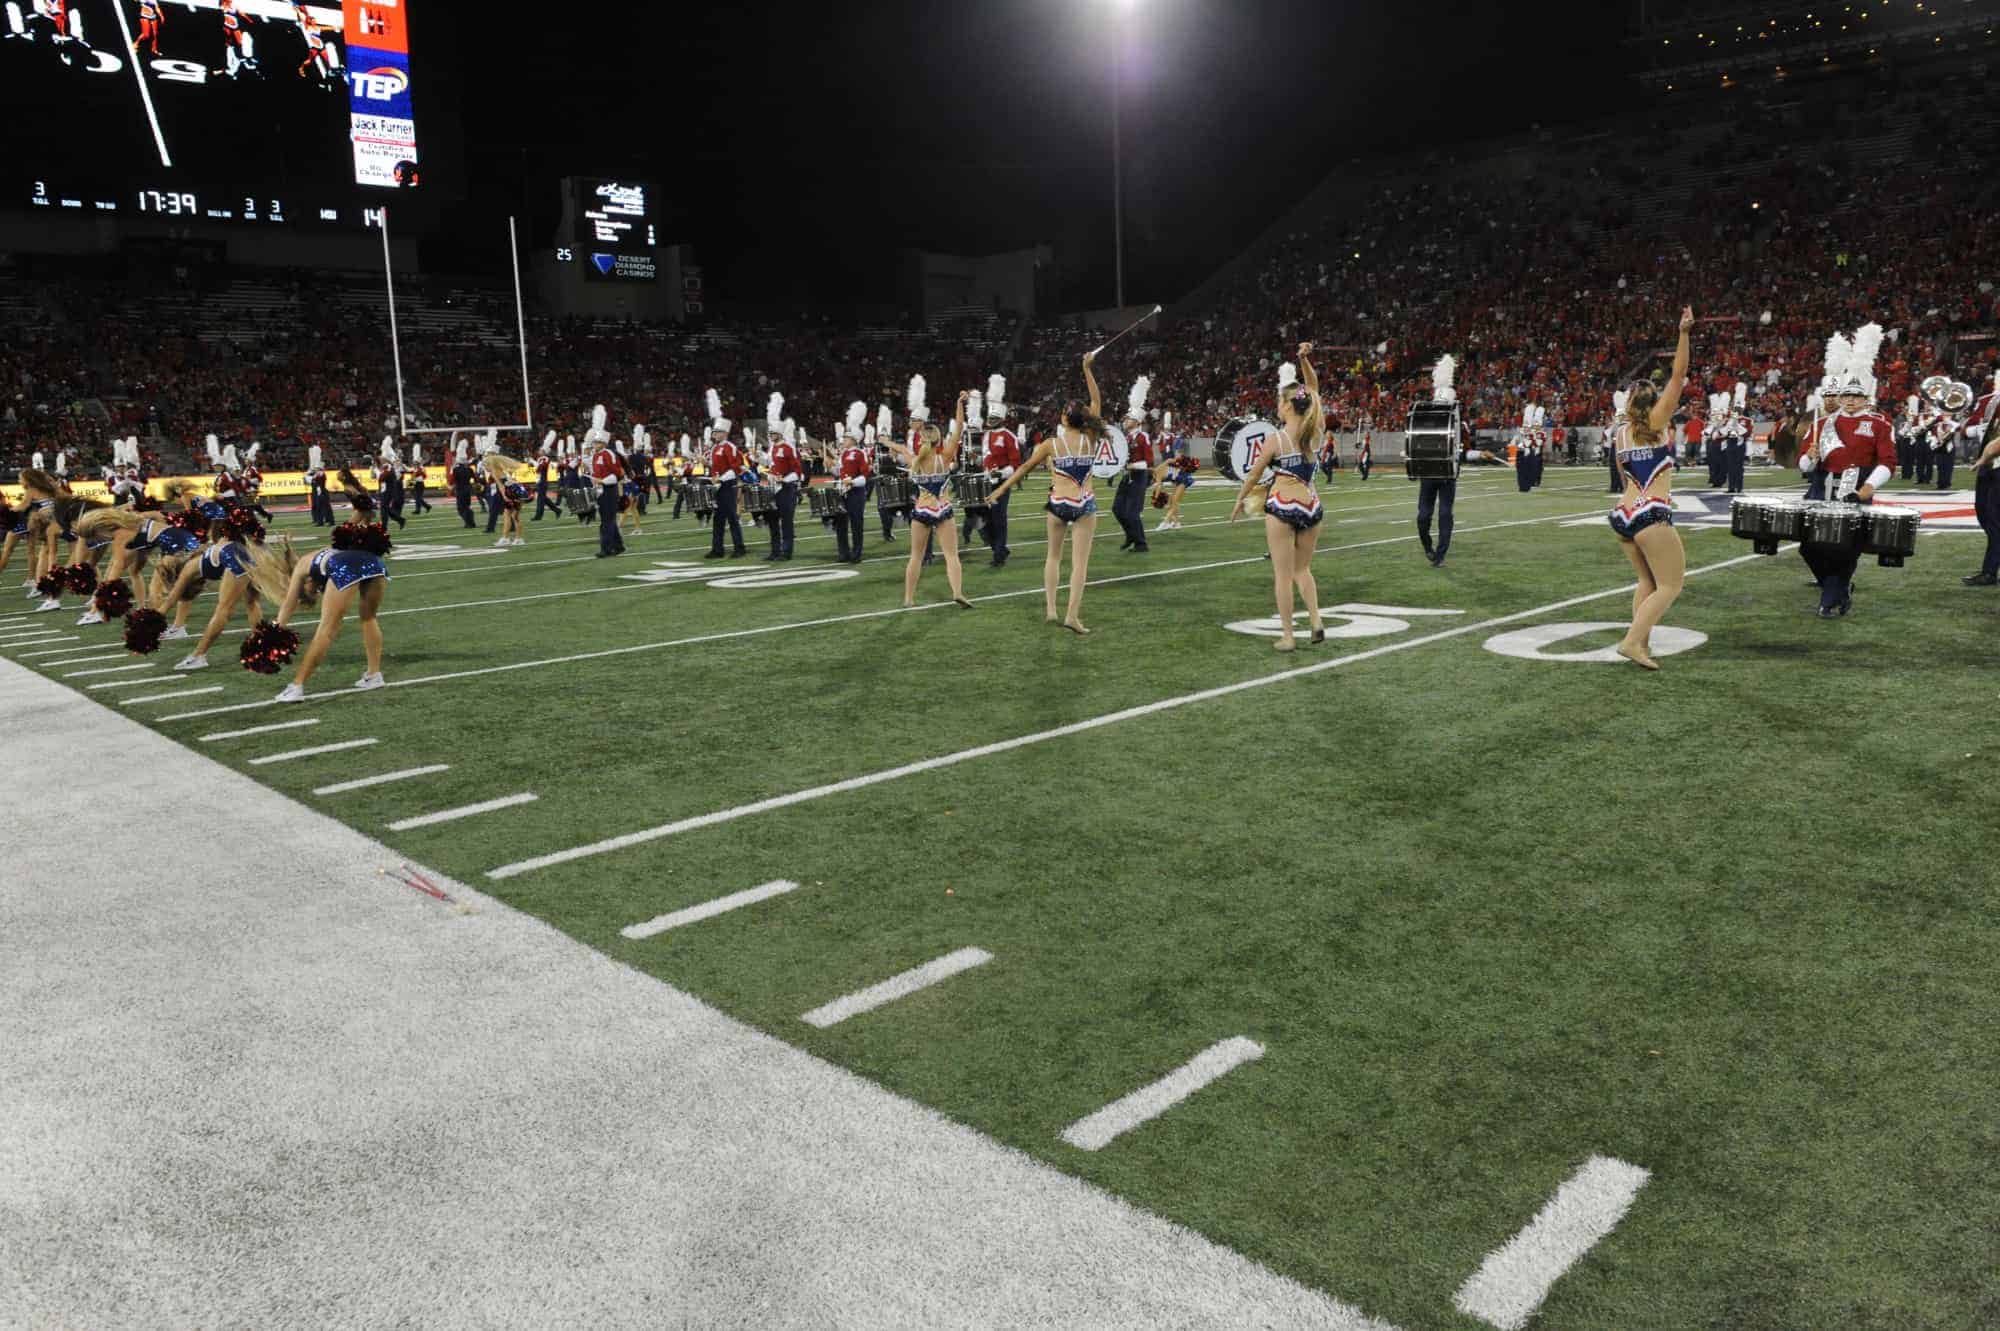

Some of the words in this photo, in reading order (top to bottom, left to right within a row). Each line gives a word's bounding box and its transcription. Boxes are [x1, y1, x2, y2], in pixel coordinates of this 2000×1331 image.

[351, 72, 402, 101] TEP
[355, 119, 377, 130] Jack
[35, 181, 45, 195] 3
[138, 191, 197, 215] 17:39
[245, 198, 254, 211] 3
[271, 200, 280, 213] 3
[364, 208, 382, 228] 14
[556, 248, 573, 262] 25
[615, 263, 656, 272] DIAMOND
[1854, 420, 1875, 437] A
[1093, 438, 1119, 465] A
